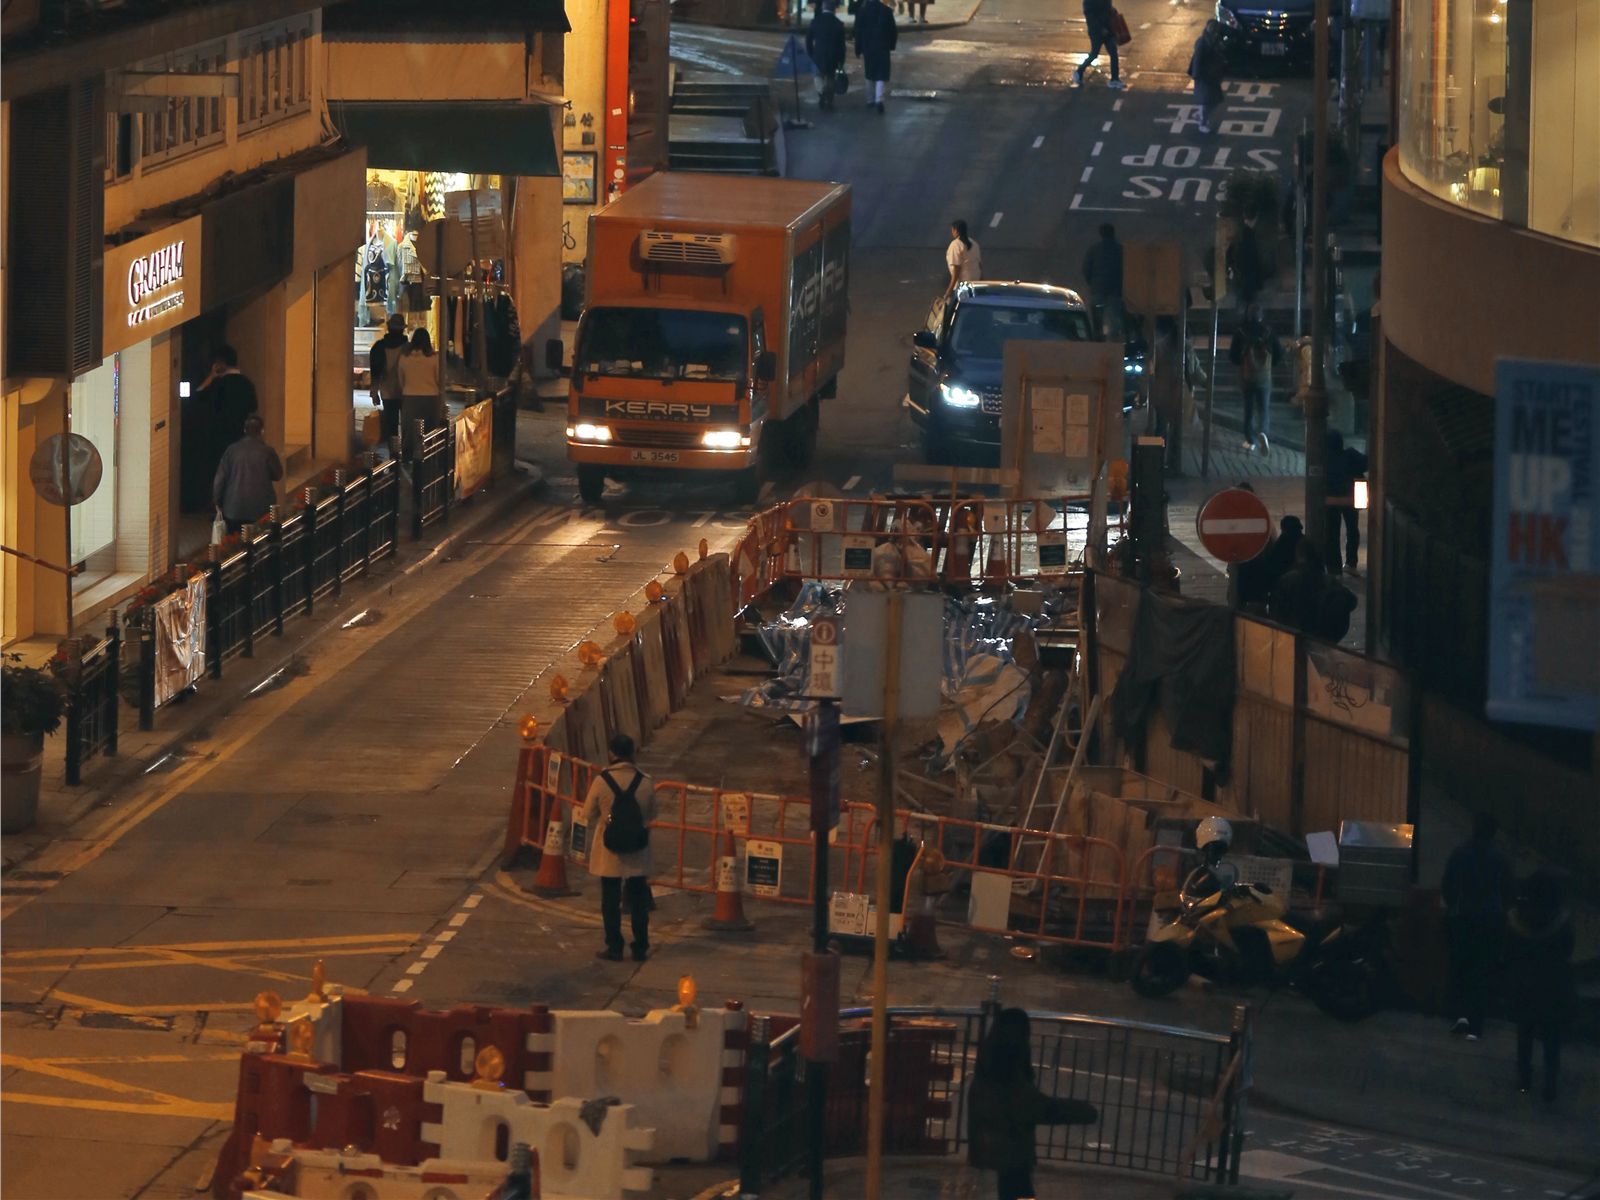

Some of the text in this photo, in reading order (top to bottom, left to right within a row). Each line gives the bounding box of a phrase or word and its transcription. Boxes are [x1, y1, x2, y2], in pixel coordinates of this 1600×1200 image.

[1121, 144, 1282, 172] STOP
[605, 400, 711, 417] KERRY
[1511, 406, 1571, 454] ME
[1510, 453, 1572, 512] UP
[1508, 510, 1569, 569] HK
